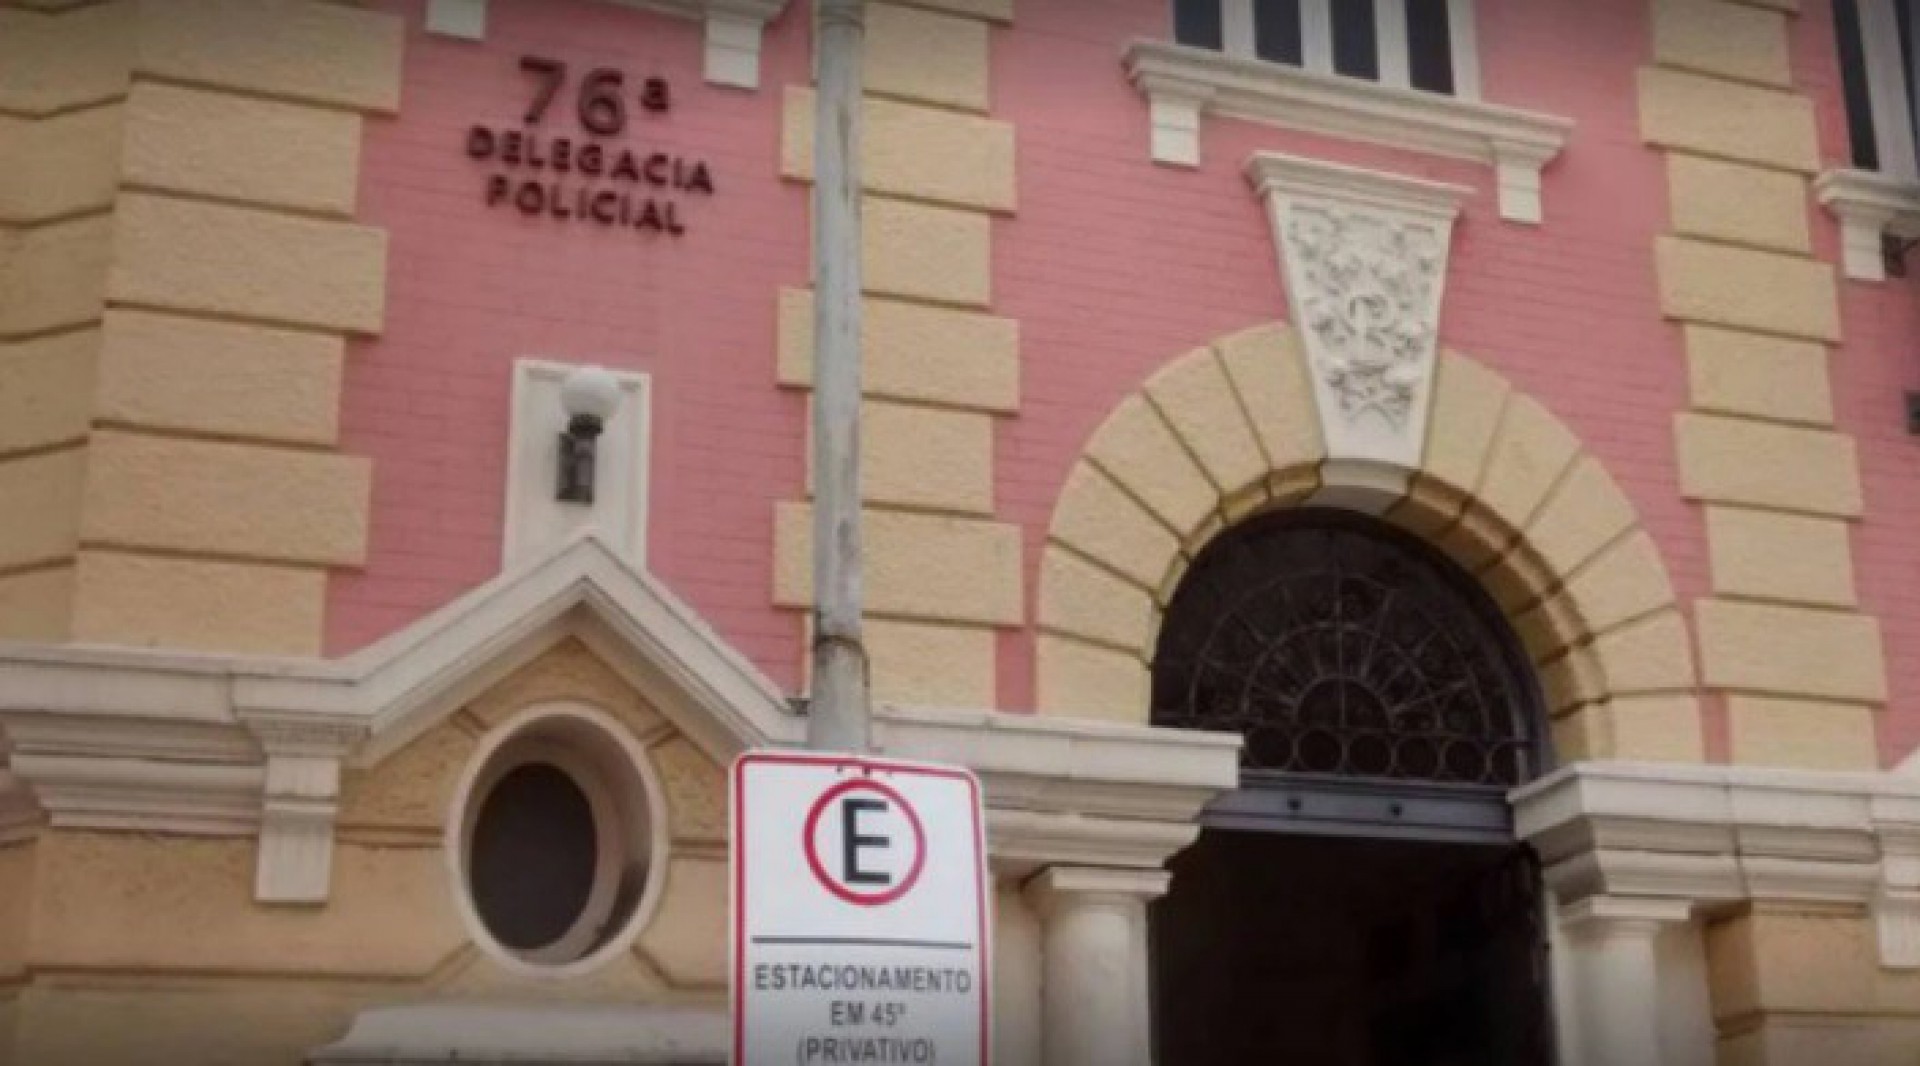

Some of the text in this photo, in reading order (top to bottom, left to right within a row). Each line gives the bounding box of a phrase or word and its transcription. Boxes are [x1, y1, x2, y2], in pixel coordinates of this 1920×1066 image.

[467, 125, 714, 194] DELEGACIA
[485, 174, 685, 236] POLICIAL
[842, 799, 891, 884] E
[754, 964, 972, 993] ESTACIONAMENTO
[830, 1001, 864, 1026] EM
[796, 1037, 936, 1065] (PRIVATIVO)
